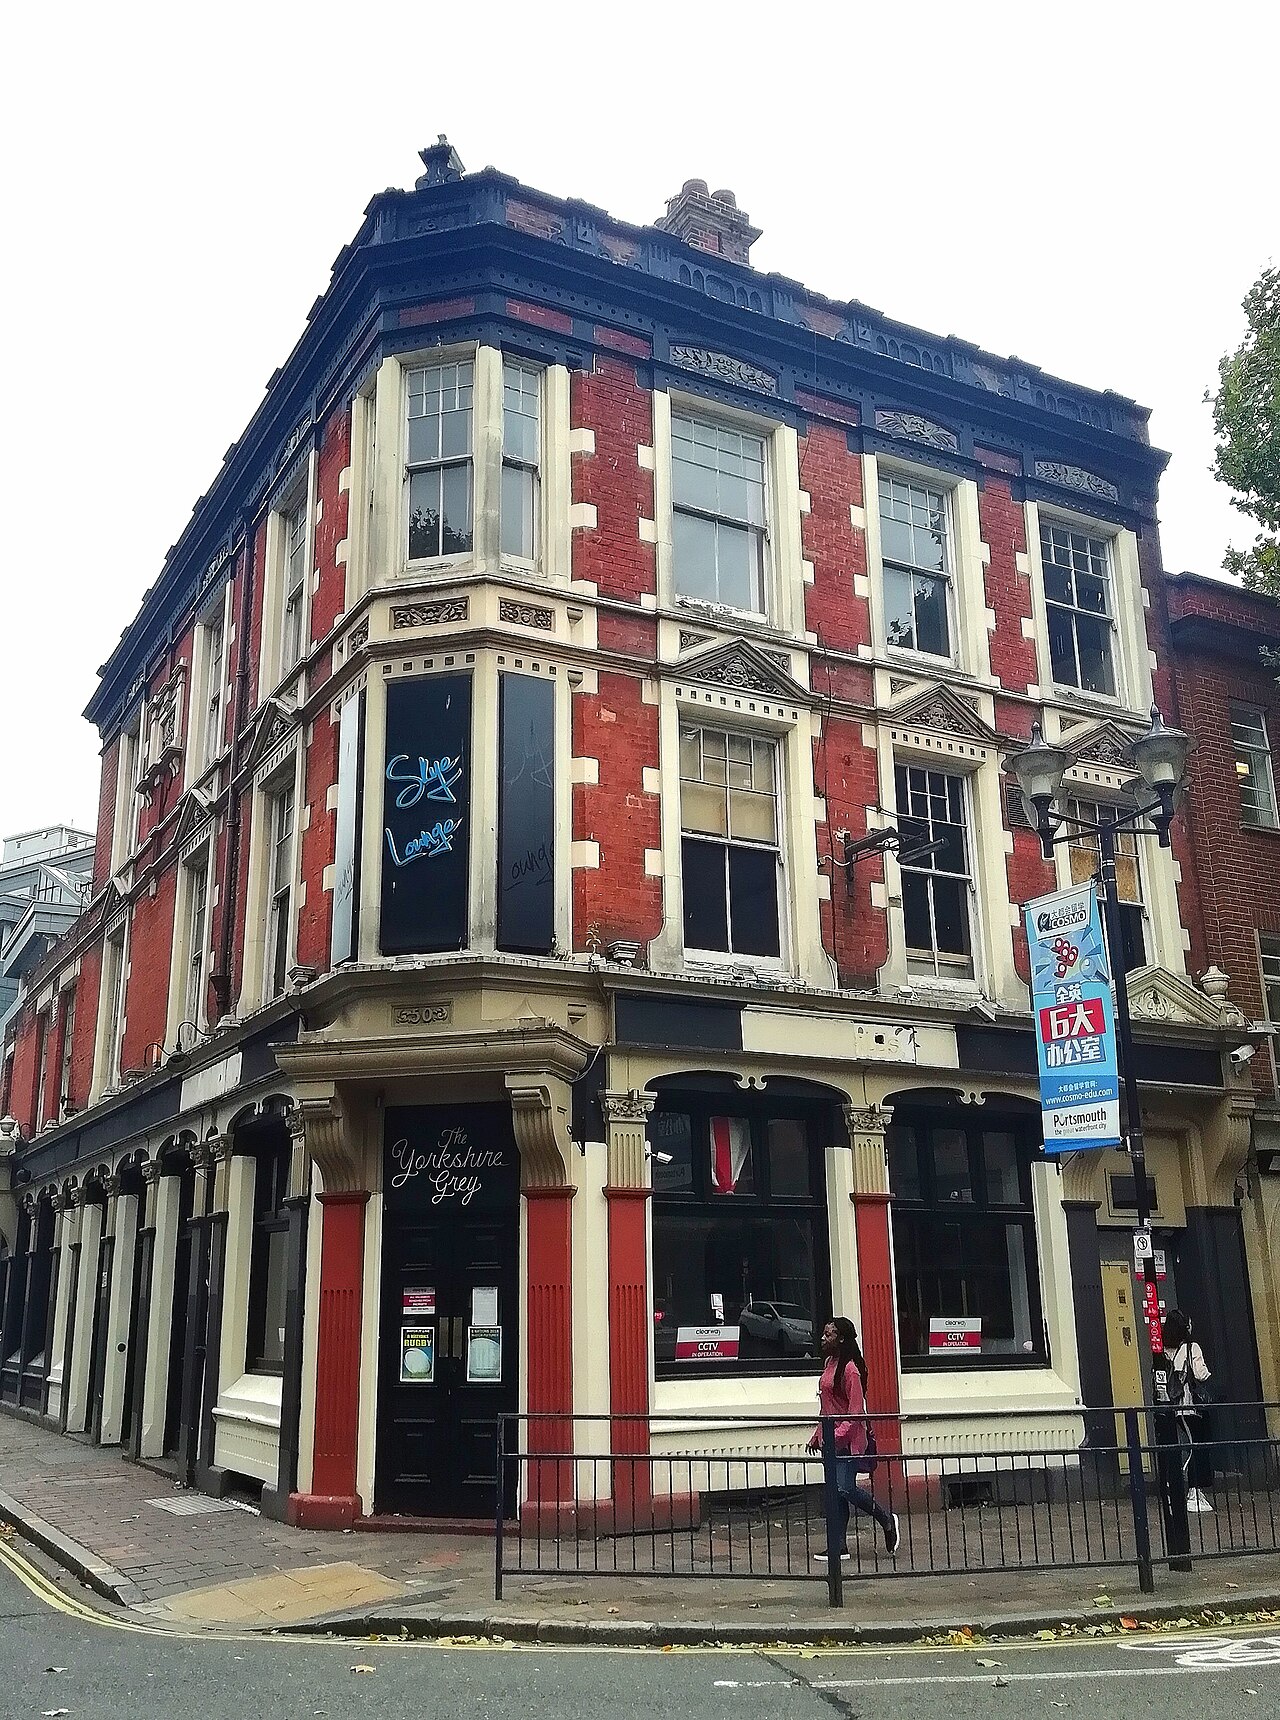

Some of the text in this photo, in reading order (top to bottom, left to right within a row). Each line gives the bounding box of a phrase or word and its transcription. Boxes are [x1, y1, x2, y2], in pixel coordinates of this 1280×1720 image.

[385, 754, 463, 810] Skye
[384, 816, 464, 867] Lounge
[1050, 910, 1087, 929] COSMO
[1056, 983, 1083, 1005] 全英
[1046, 1036, 1102, 1067] 办公室
[1045, 1088, 1113, 1105] www.cosmo-edu.com
[1053, 1107, 1107, 1128] Portsmouth
[1098, 1122, 1107, 1130] city
[437, 1126, 468, 1148] The
[391, 1138, 511, 1188] Yorkshire
[428, 1169, 482, 1206] Grey
[404, 1339, 432, 1347] RUGBY
[698, 1342, 719, 1351] CCTV
[947, 1332, 965, 1341] CCTV
